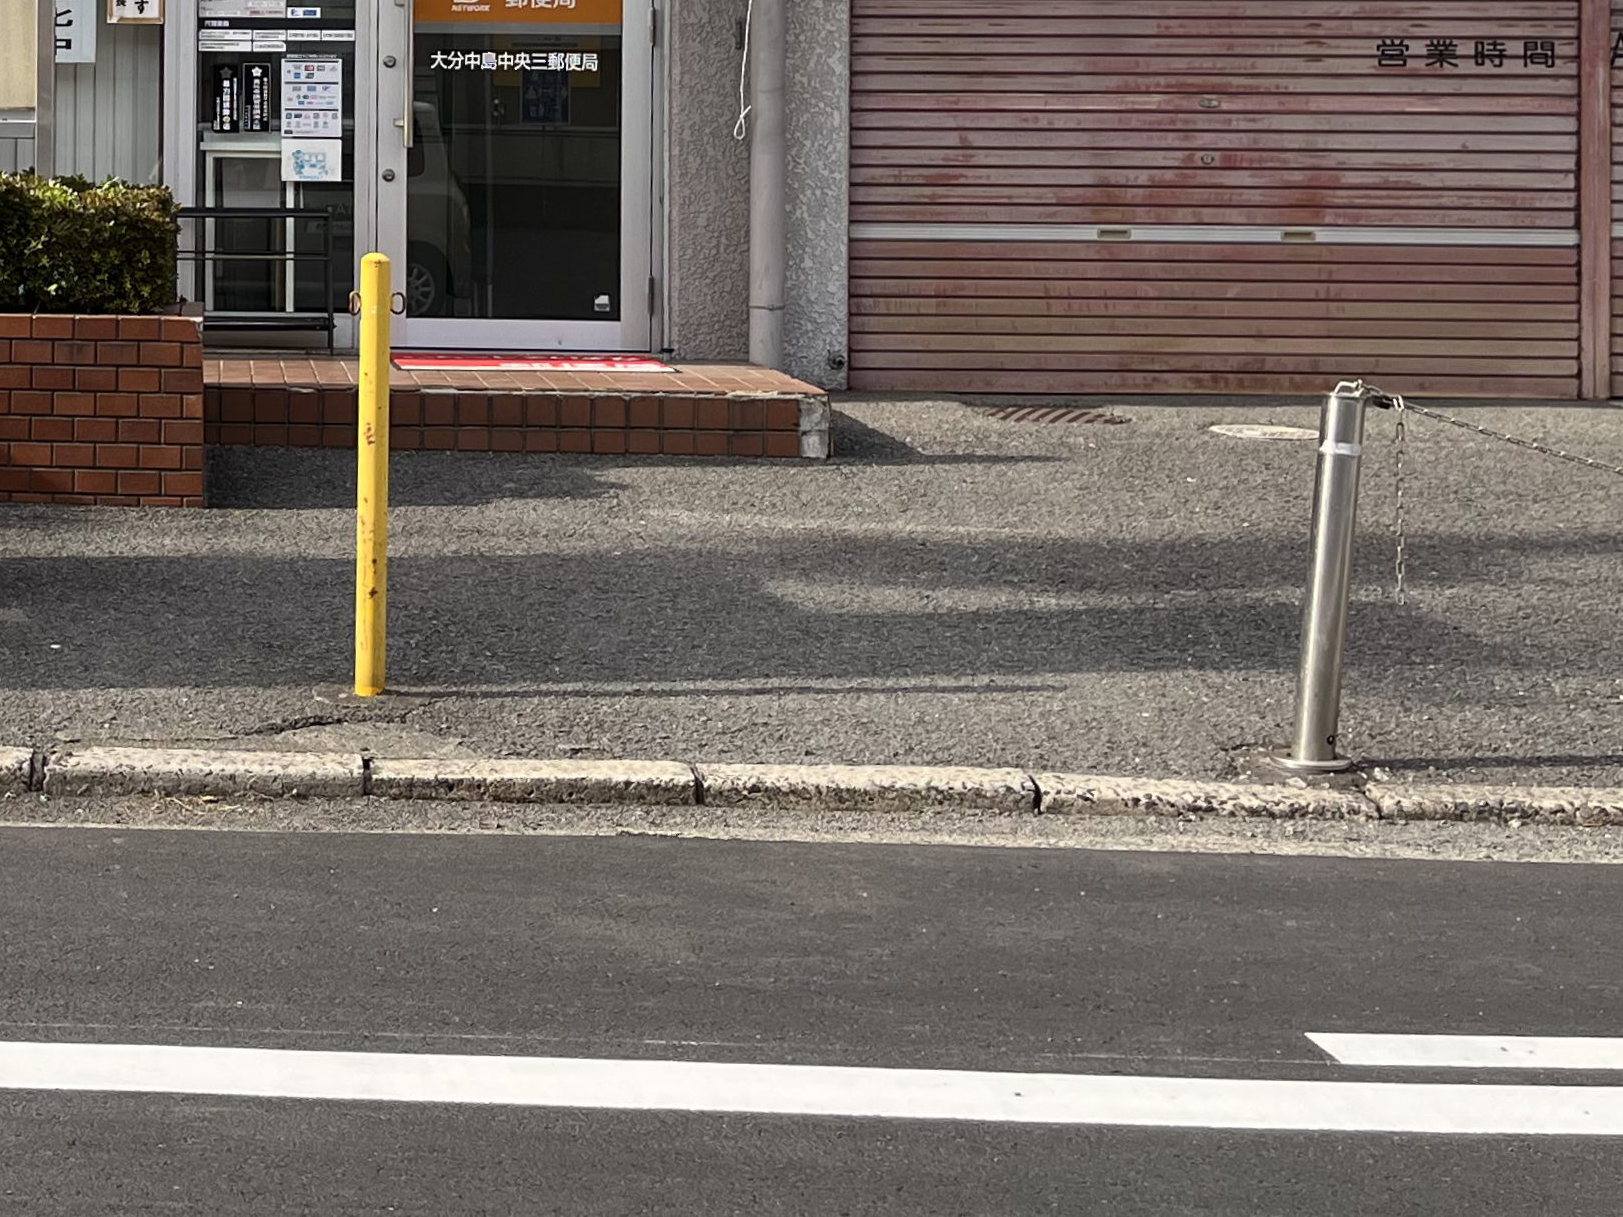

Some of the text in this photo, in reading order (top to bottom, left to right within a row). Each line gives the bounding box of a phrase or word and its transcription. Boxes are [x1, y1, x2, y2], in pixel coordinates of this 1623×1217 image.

[430, 51, 598, 71] 大分中島中央三郵便局
[1376, 38, 1556, 68] 営業時間
